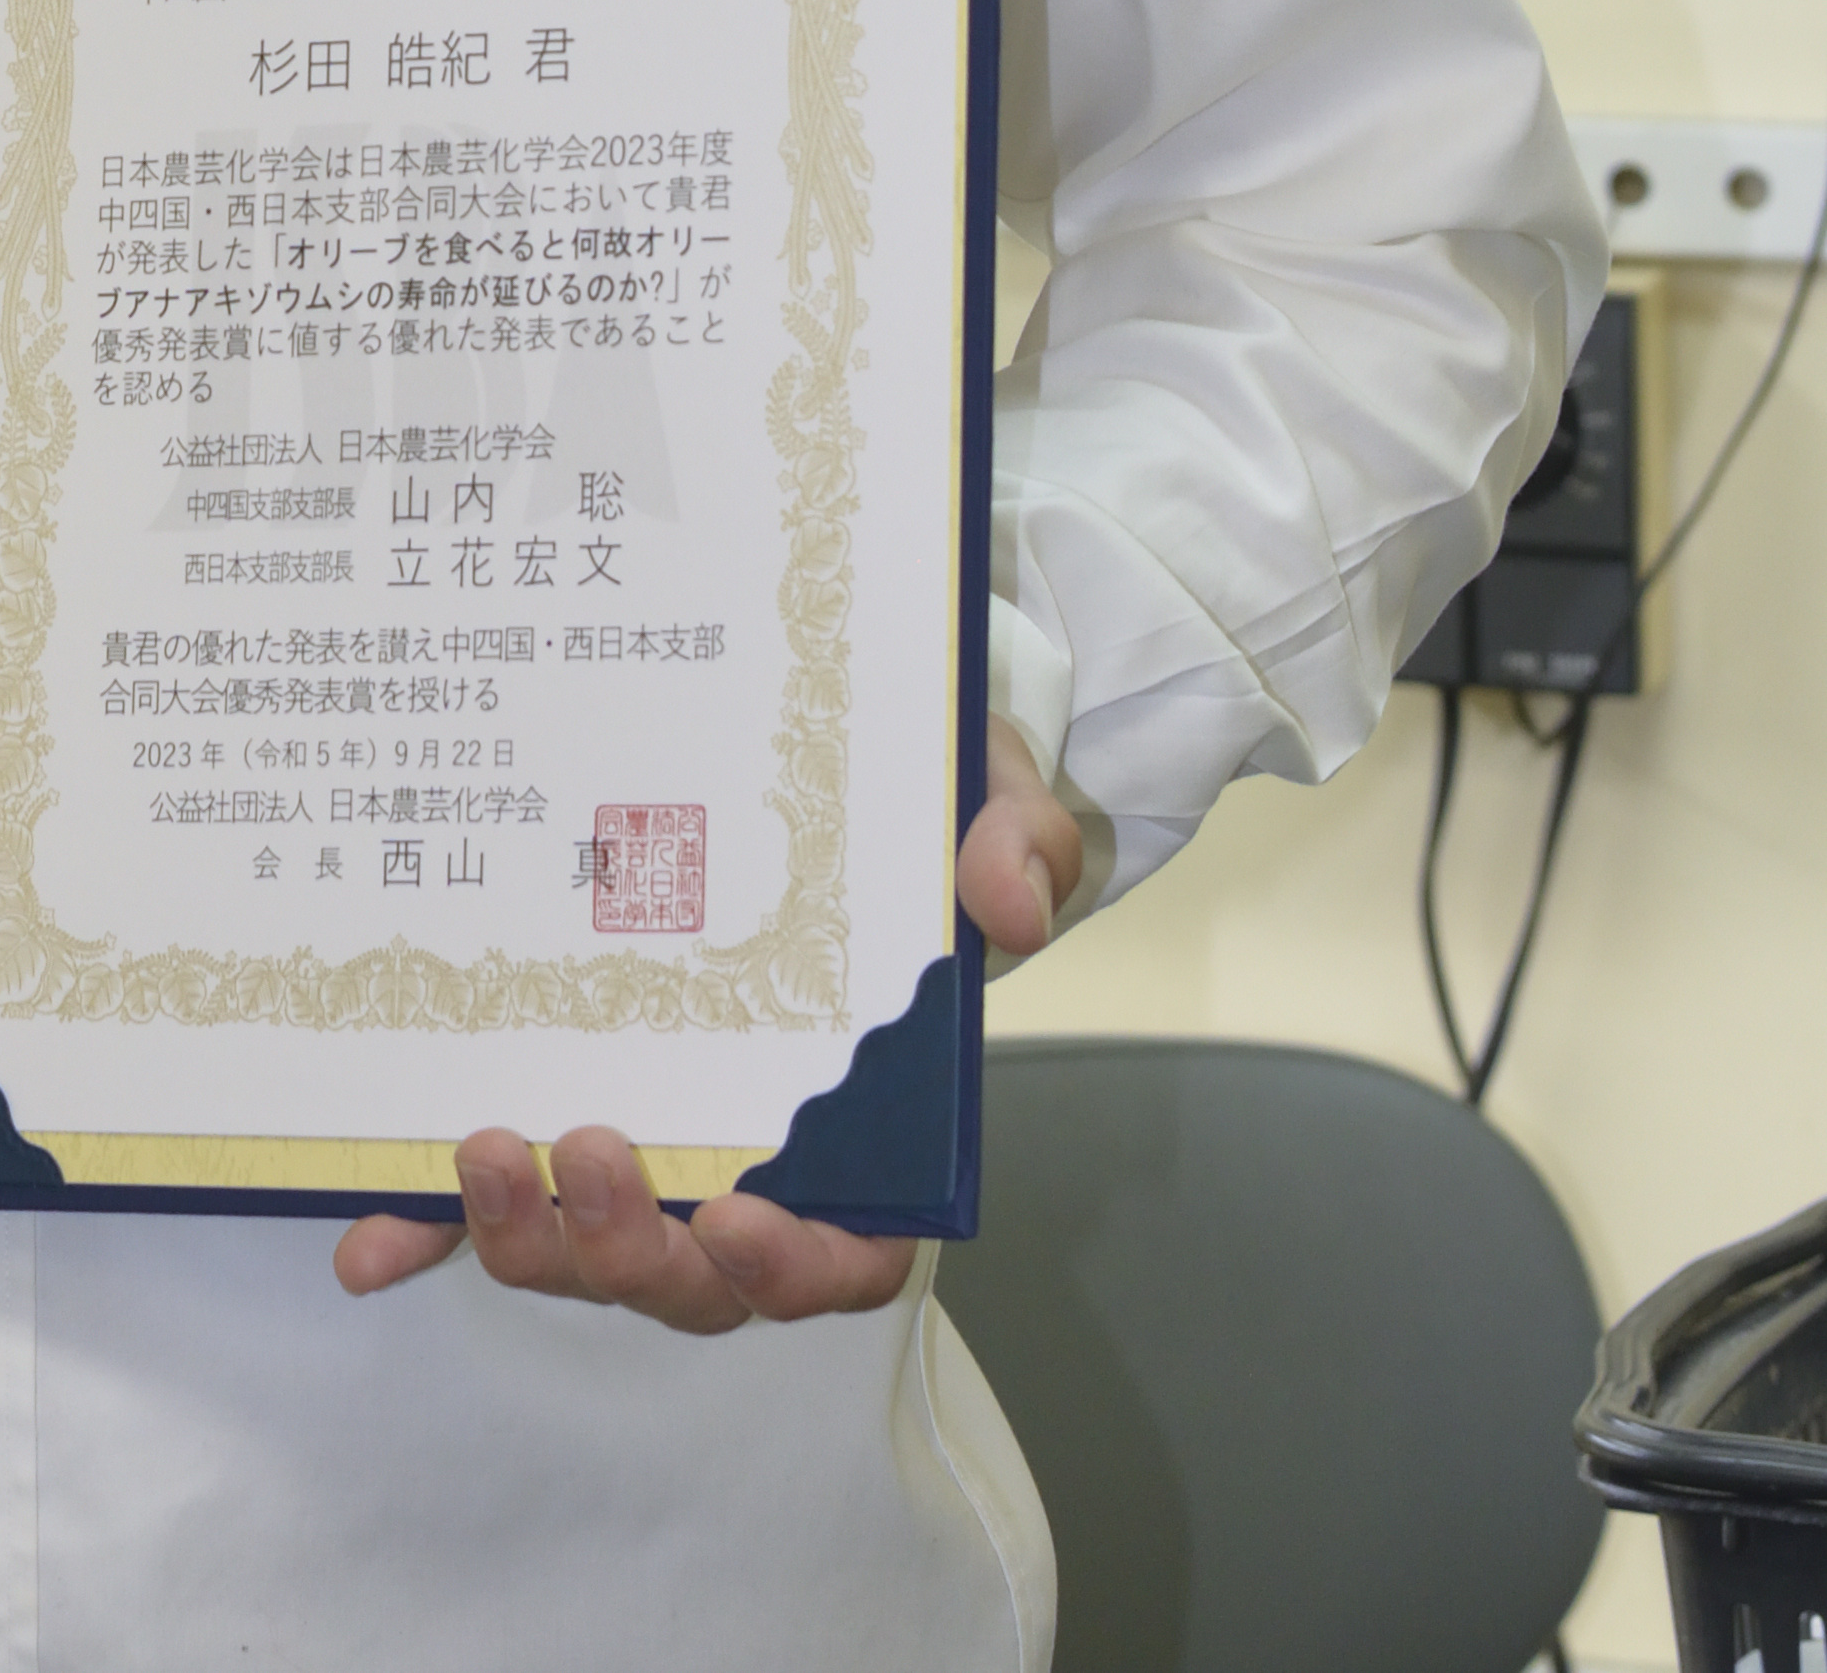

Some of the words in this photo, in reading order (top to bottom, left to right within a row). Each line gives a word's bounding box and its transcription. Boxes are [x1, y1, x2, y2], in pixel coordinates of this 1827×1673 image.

[94, 371, 212, 406] を認める
[161, 433, 322, 467] 公益社団法人
[340, 423, 555, 463] 日本農芸化学会
[187, 487, 355, 522] 中四国支部支部長
[185, 551, 353, 584] 西日本支部支部長
[100, 676, 498, 715] 合同大会優秀発表賞を授ける
[150, 790, 313, 823] 公益社団法人
[331, 786, 548, 823] 日本農芸化学会
